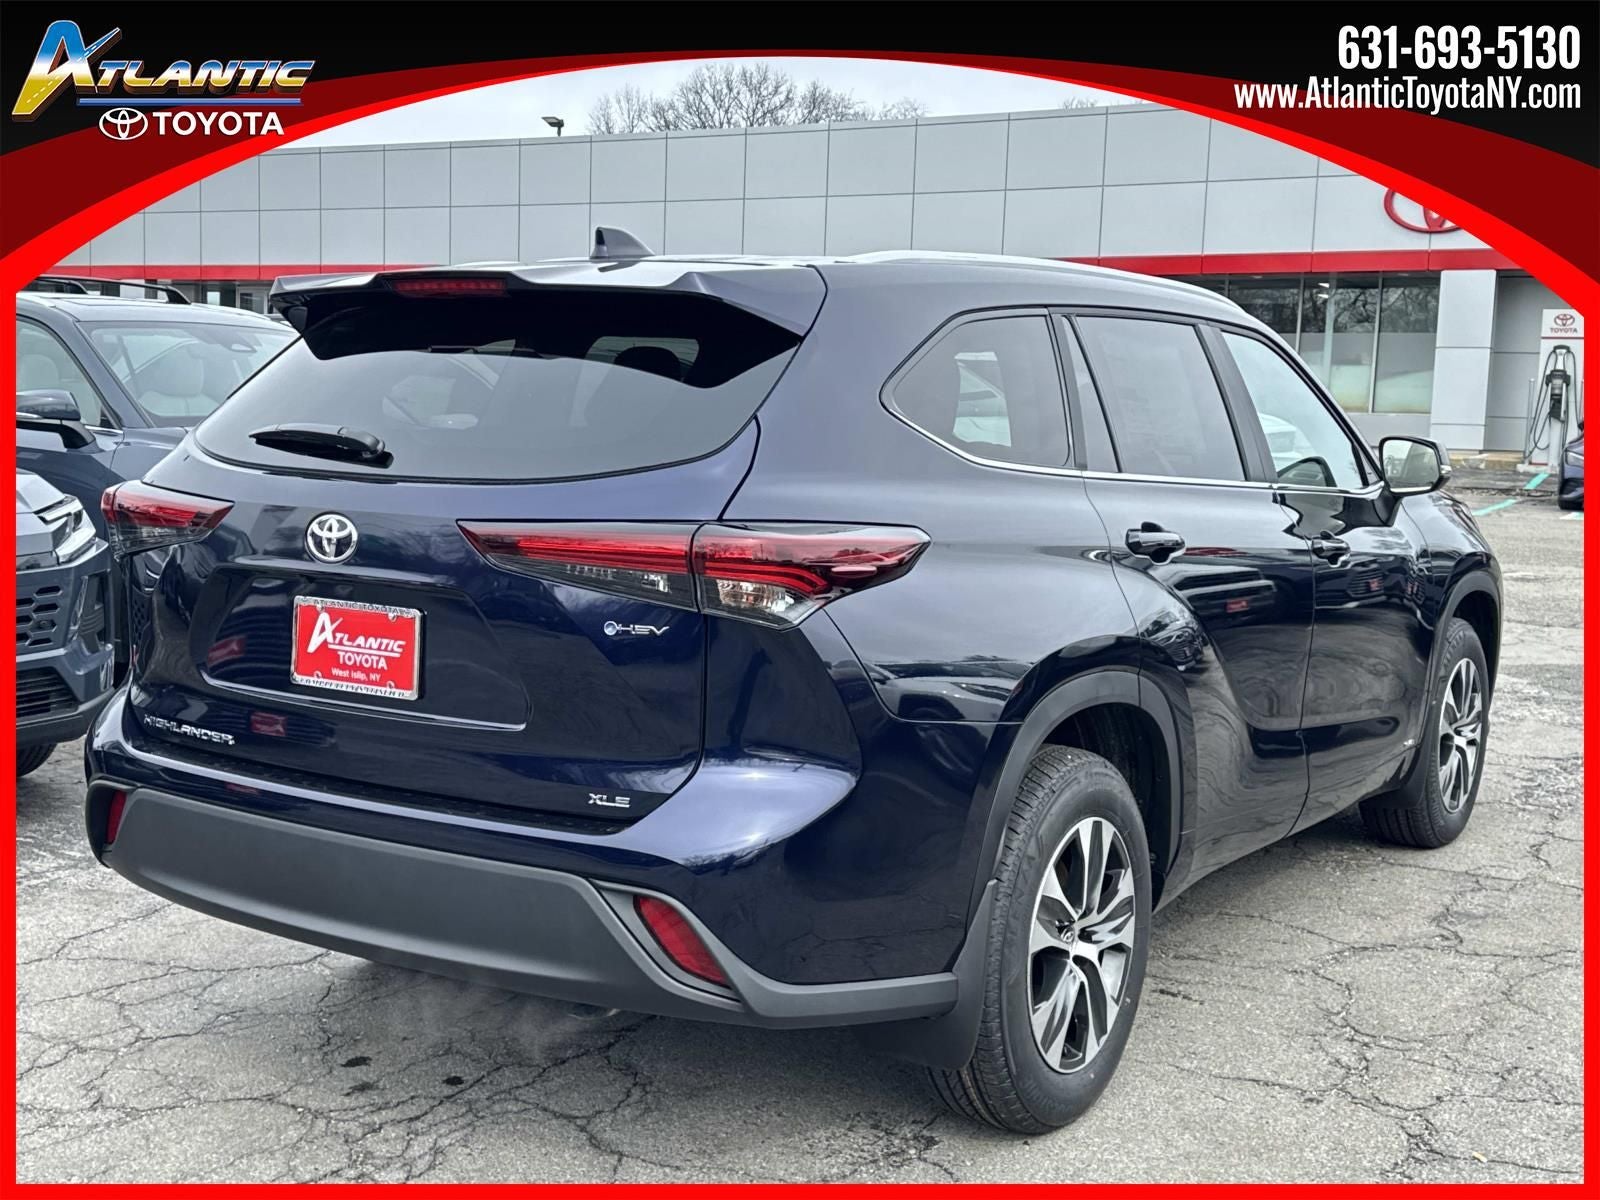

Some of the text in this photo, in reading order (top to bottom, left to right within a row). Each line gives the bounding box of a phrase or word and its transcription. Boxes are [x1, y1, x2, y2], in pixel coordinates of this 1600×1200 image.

[313, 600, 398, 613] ATLANTIC TOYOTA
[307, 612, 406, 653] ATLANTIC
[337, 651, 388, 670] TOYOTA
[331, 667, 350, 678] West
[370, 674, 381, 682] NY
[144, 713, 234, 744] HIGHLANDER
[588, 793, 631, 808] XLE
